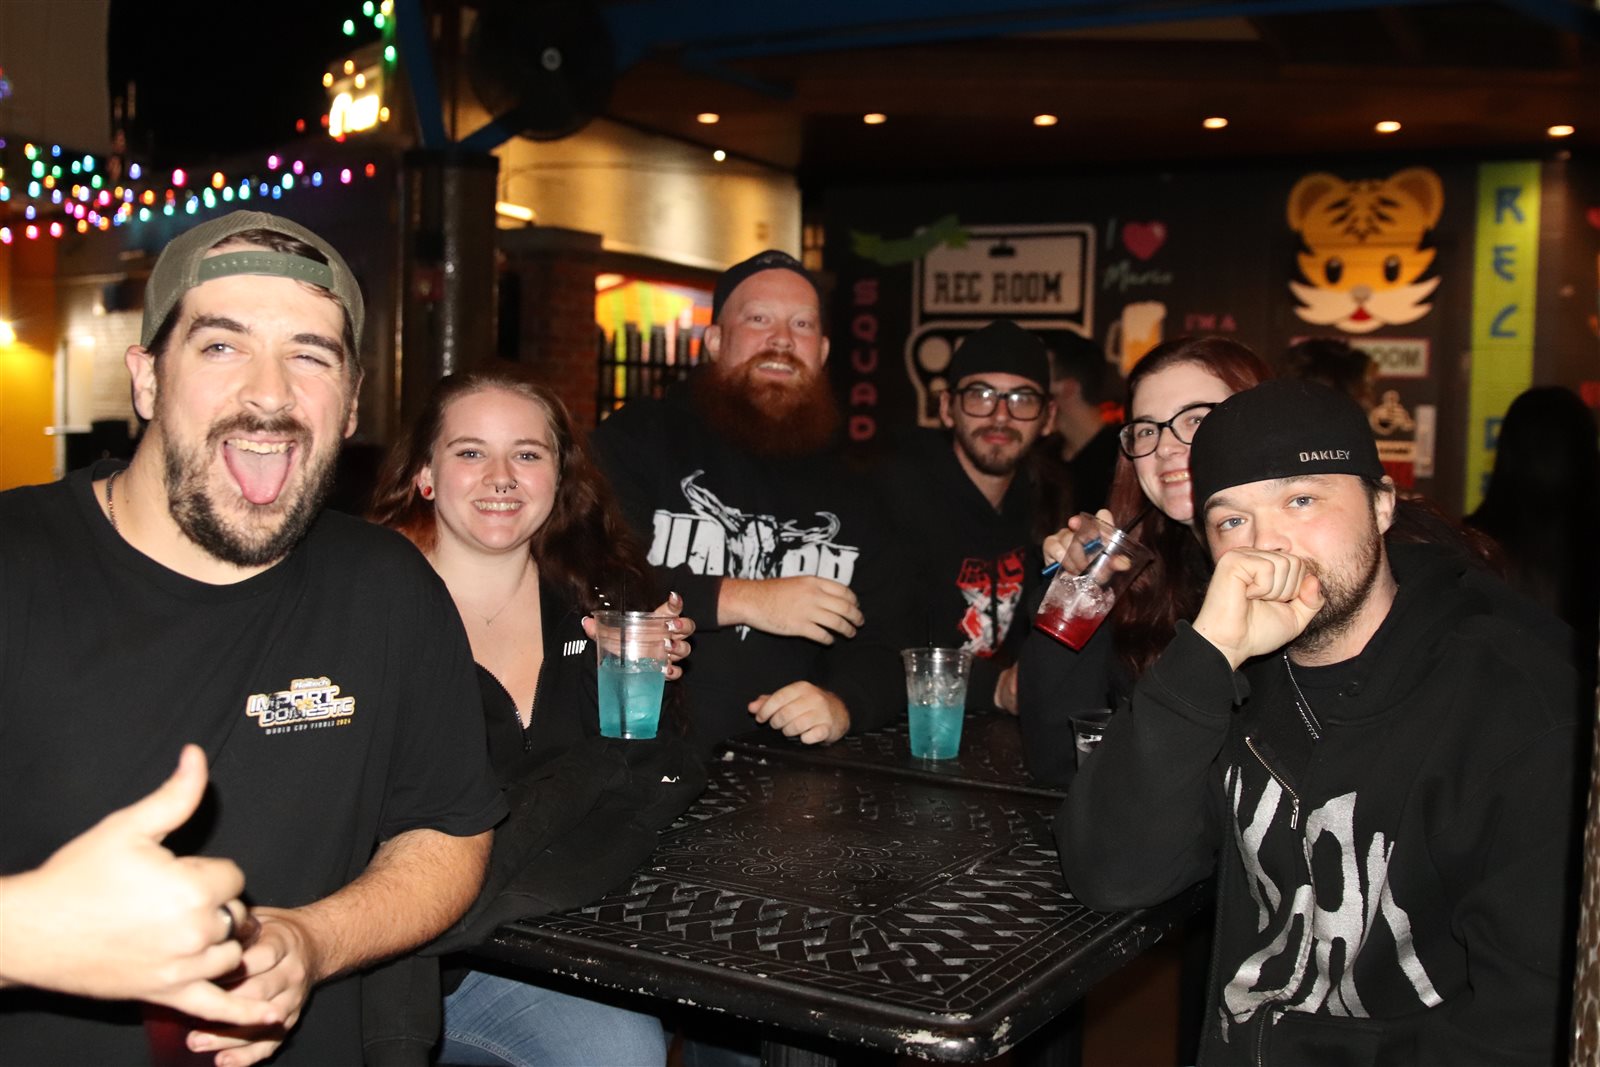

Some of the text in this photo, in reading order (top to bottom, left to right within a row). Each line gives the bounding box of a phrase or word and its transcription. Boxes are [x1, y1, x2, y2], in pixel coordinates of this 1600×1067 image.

[932, 269, 1064, 305] REC ROOM
[848, 278, 880, 441] SQUAD
[1299, 448, 1350, 463] OAKLEY
[250, 687, 338, 713] IMPORT
[262, 699, 354, 724] DOMESTIC
[265, 725, 291, 735] WORLD
[294, 723, 308, 732] CUP
